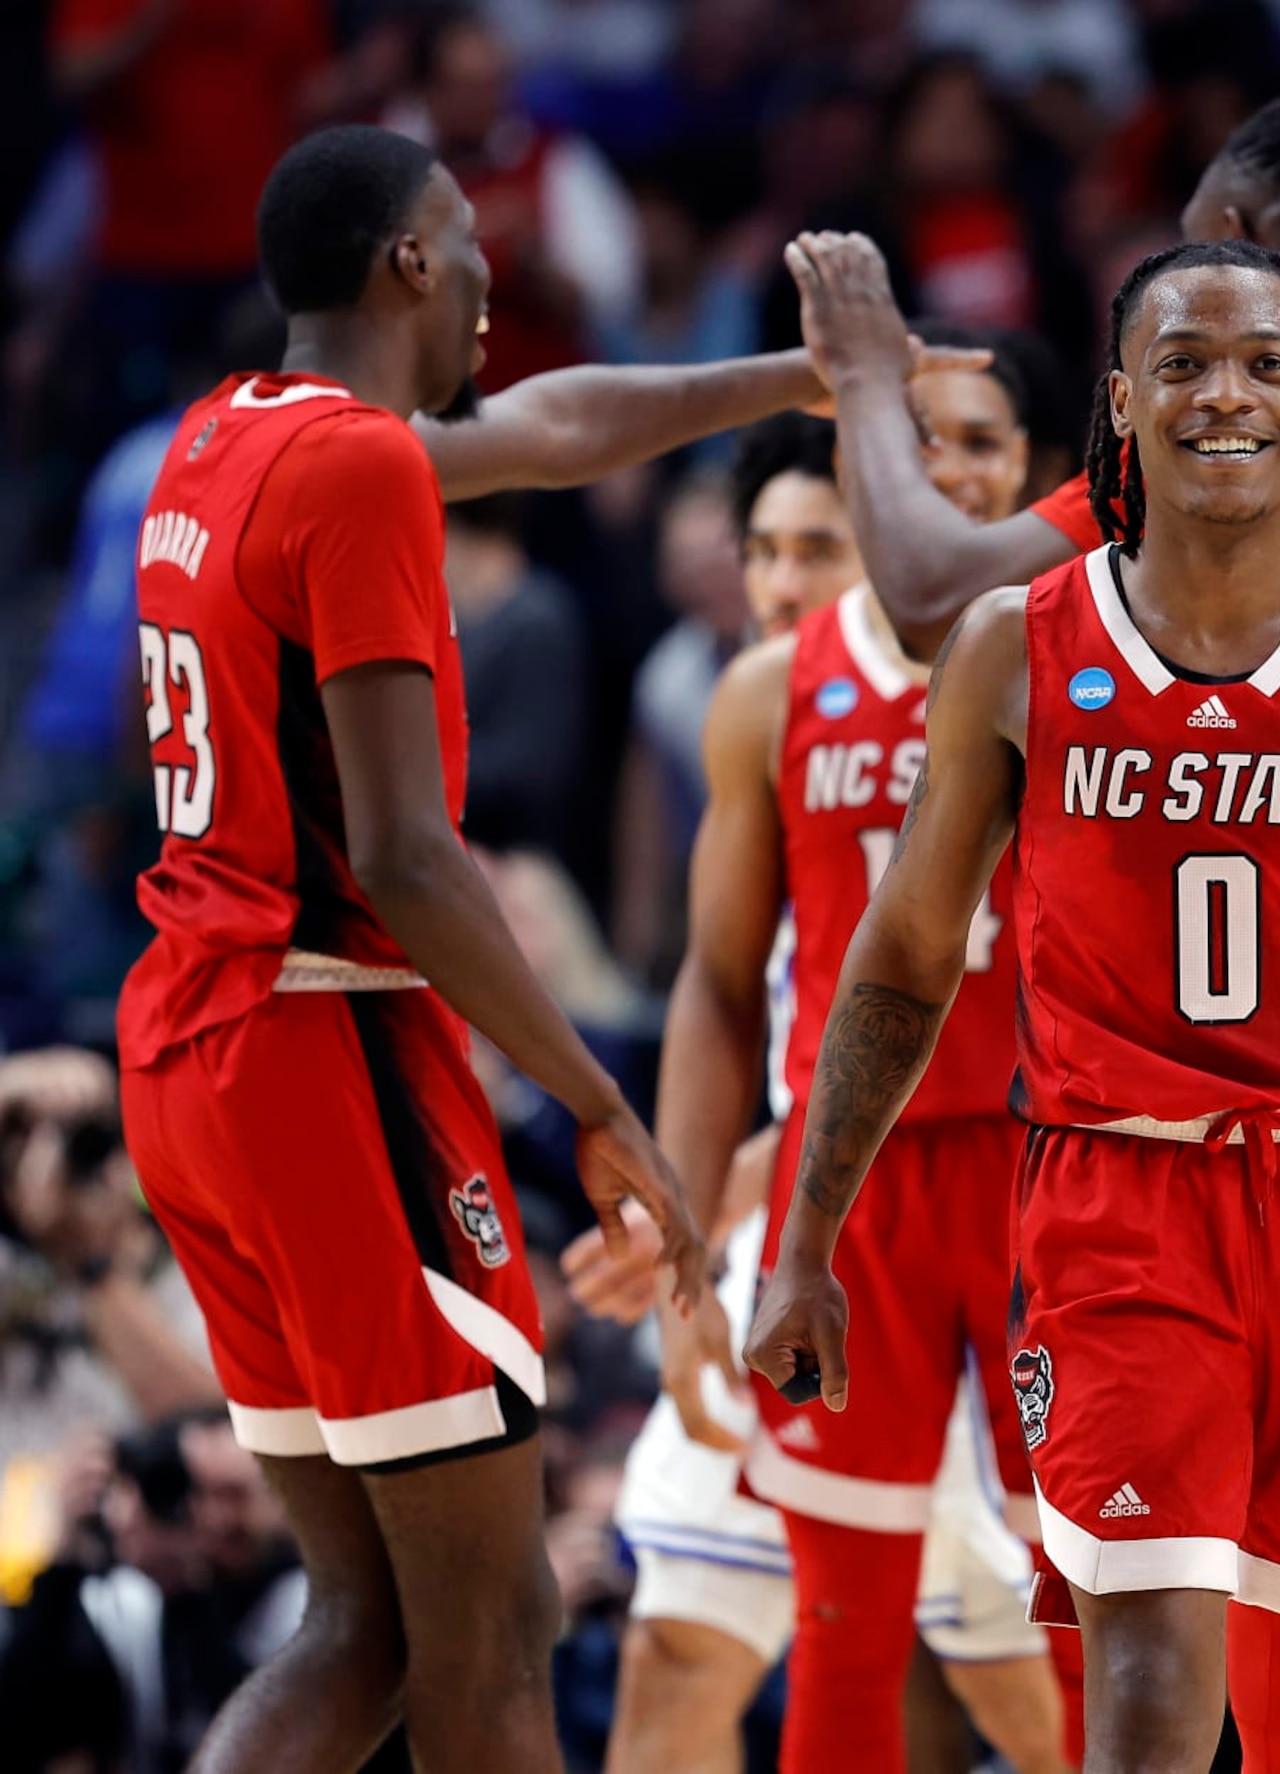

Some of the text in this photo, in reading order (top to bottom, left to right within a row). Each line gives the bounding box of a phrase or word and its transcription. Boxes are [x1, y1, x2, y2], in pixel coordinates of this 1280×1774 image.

[1075, 686, 1112, 700] NCAA
[1186, 714, 1237, 729] adidas
[138, 622, 216, 840] 23
[804, 741, 883, 814] NC
[1063, 746, 1152, 819] NC
[1173, 851, 1262, 1026] 0
[1099, 1503, 1150, 1519] adidas
